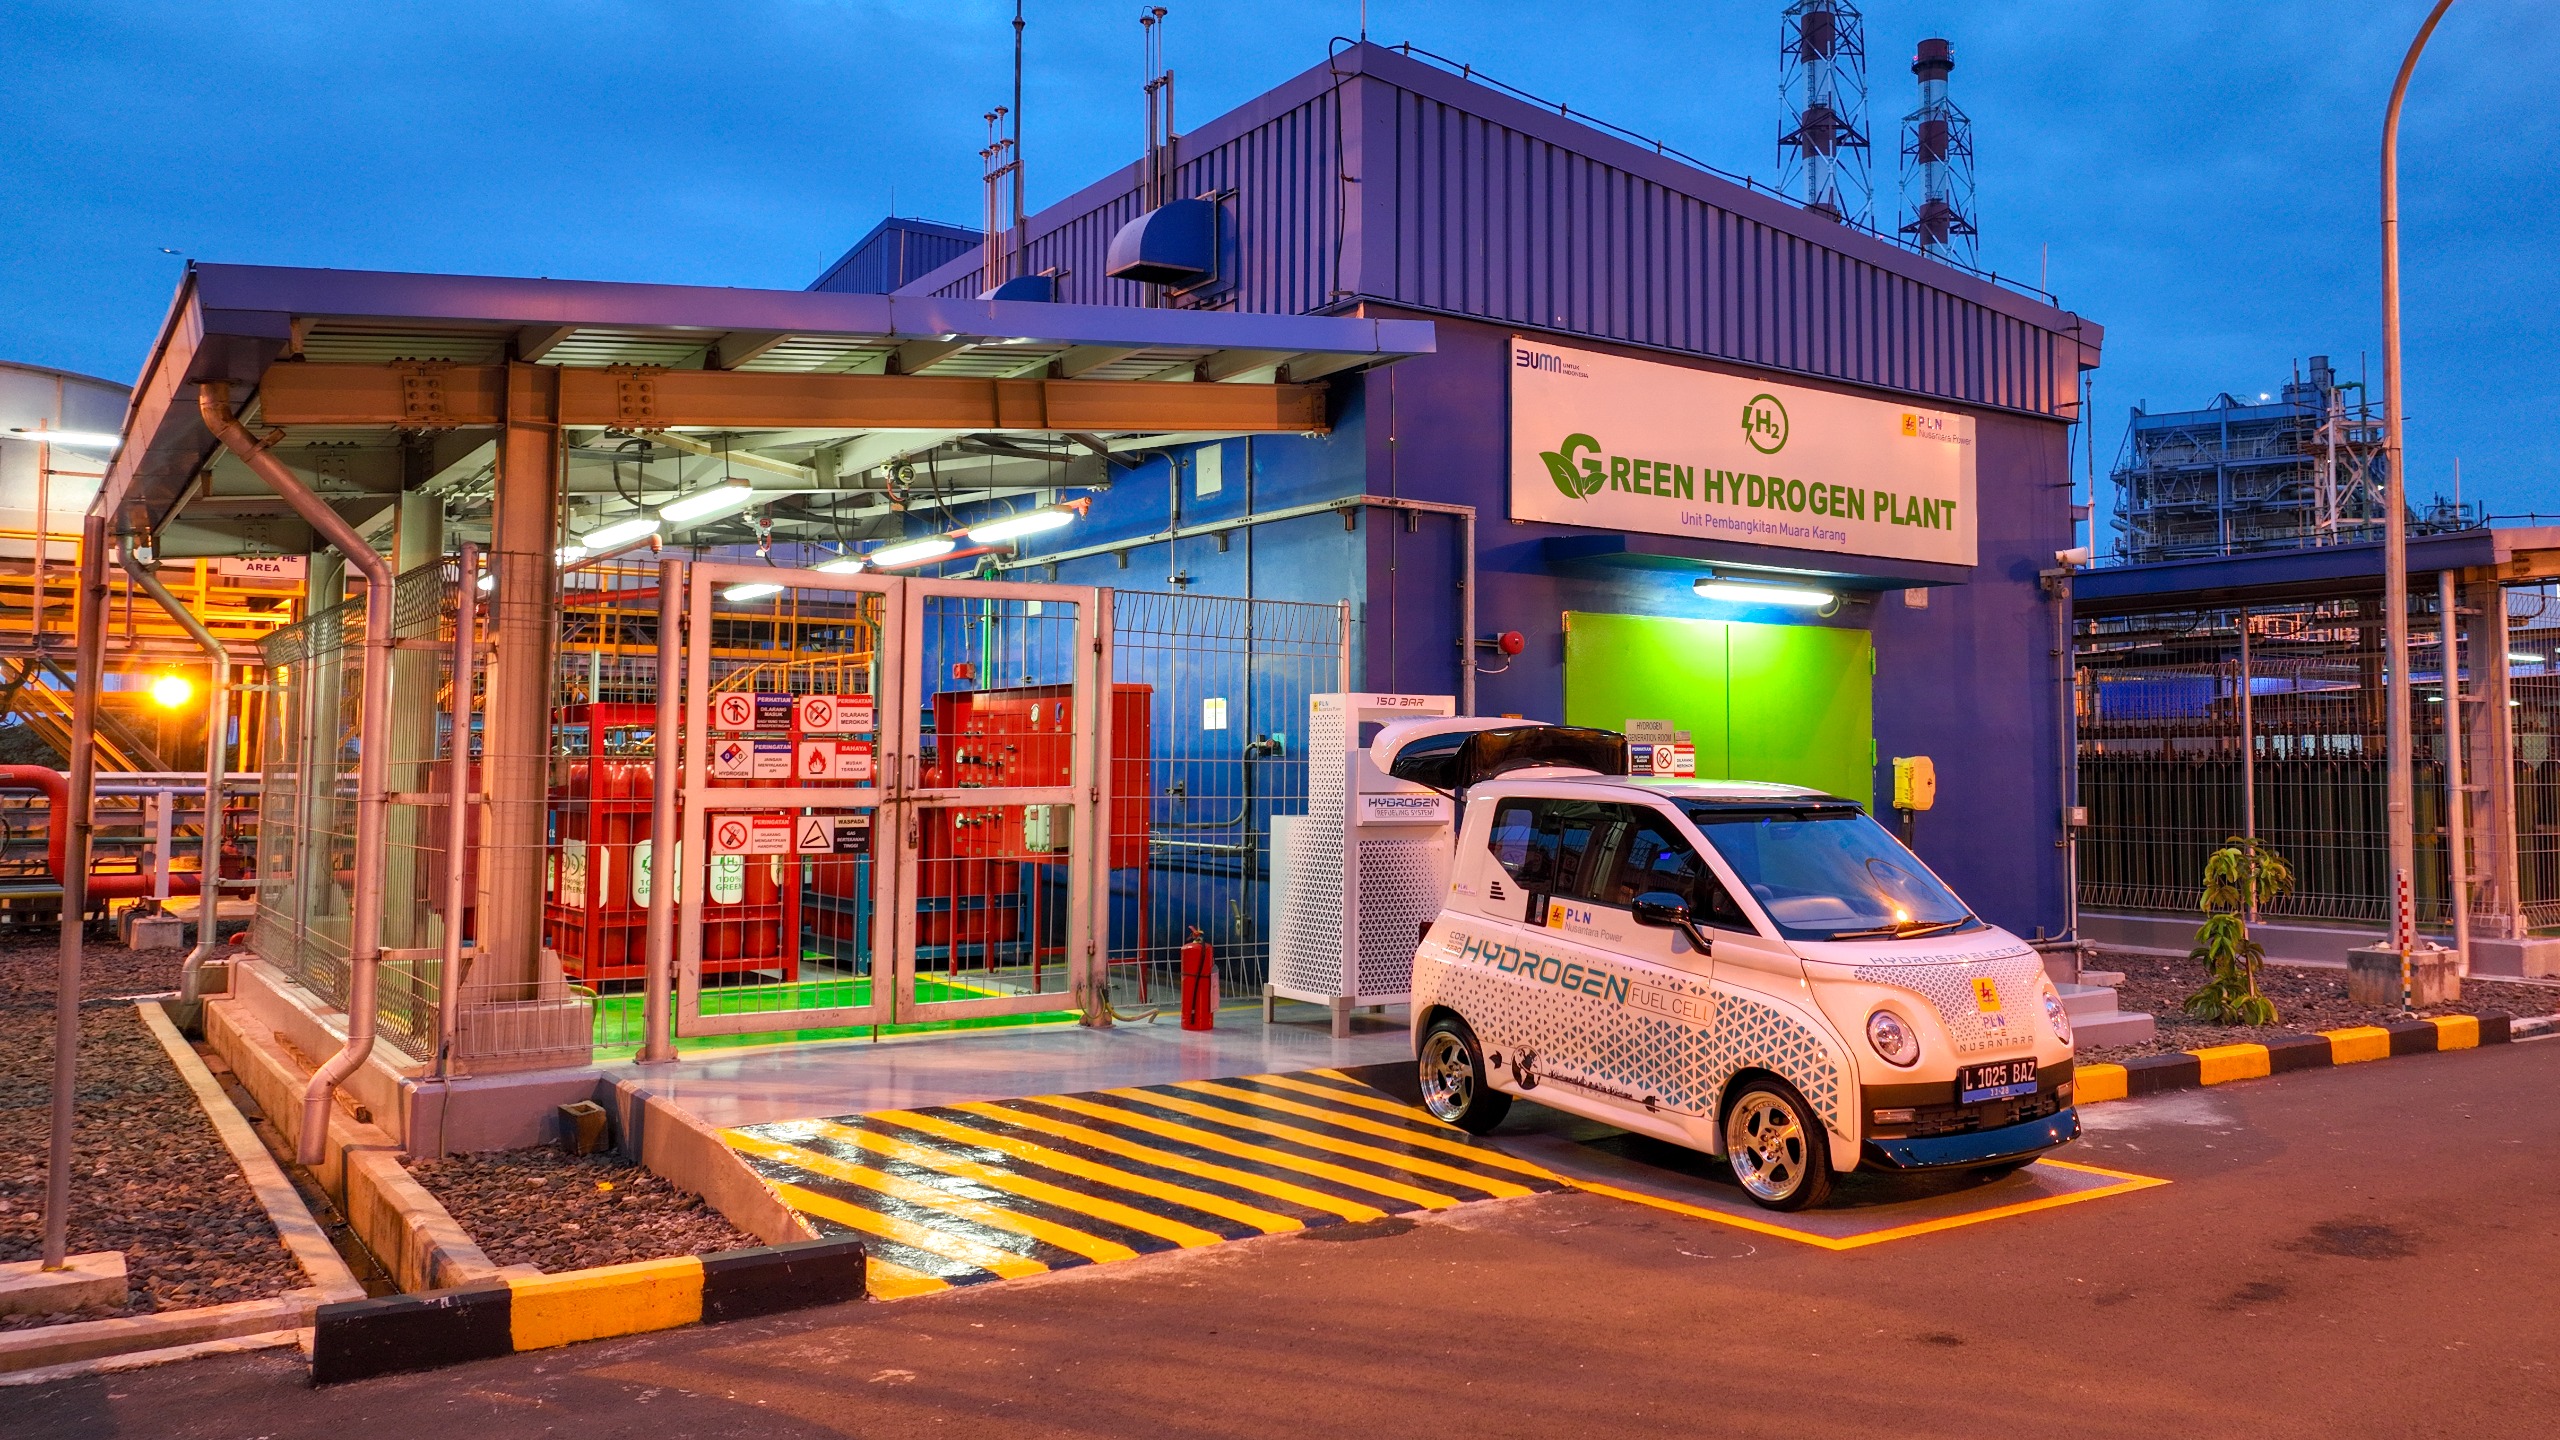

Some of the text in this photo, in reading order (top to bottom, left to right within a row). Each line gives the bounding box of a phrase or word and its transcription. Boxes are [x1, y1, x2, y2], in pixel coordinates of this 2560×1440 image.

[1516, 349, 1562, 373] BUMN
[1562, 370, 1589, 378] INDONESIA
[1918, 416, 1942, 430] PLN
[1952, 435, 1972, 445] Power
[1559, 433, 1957, 531] GREEN HYDROGEN PLANT
[1682, 512, 1846, 544] Unit Pembangkitan Muara Karang
[246, 564, 280, 572] AREA
[1376, 697, 1424, 706] 150 BAR
[1637, 722, 1662, 730] HYDROGEN
[1628, 734, 1656, 742] GENERATION
[1658, 734, 1671, 742] ROOM
[1369, 798, 1440, 807] HYDROGEN
[1566, 908, 1591, 925] PLN
[1450, 931, 1465, 941] CO2
[1565, 922, 1623, 942] Nusantara Power
[1870, 945, 2027, 964] HYDROGEN ELECTRIC
[1460, 936, 1630, 1004] HYDROGEN
[1631, 988, 1708, 1022] FUEL CELL
[1982, 1015, 2005, 1028] PLN
[1960, 1035, 2034, 1052] NUSANTARA
[1966, 1062, 2035, 1090] L 1025 BAZ
